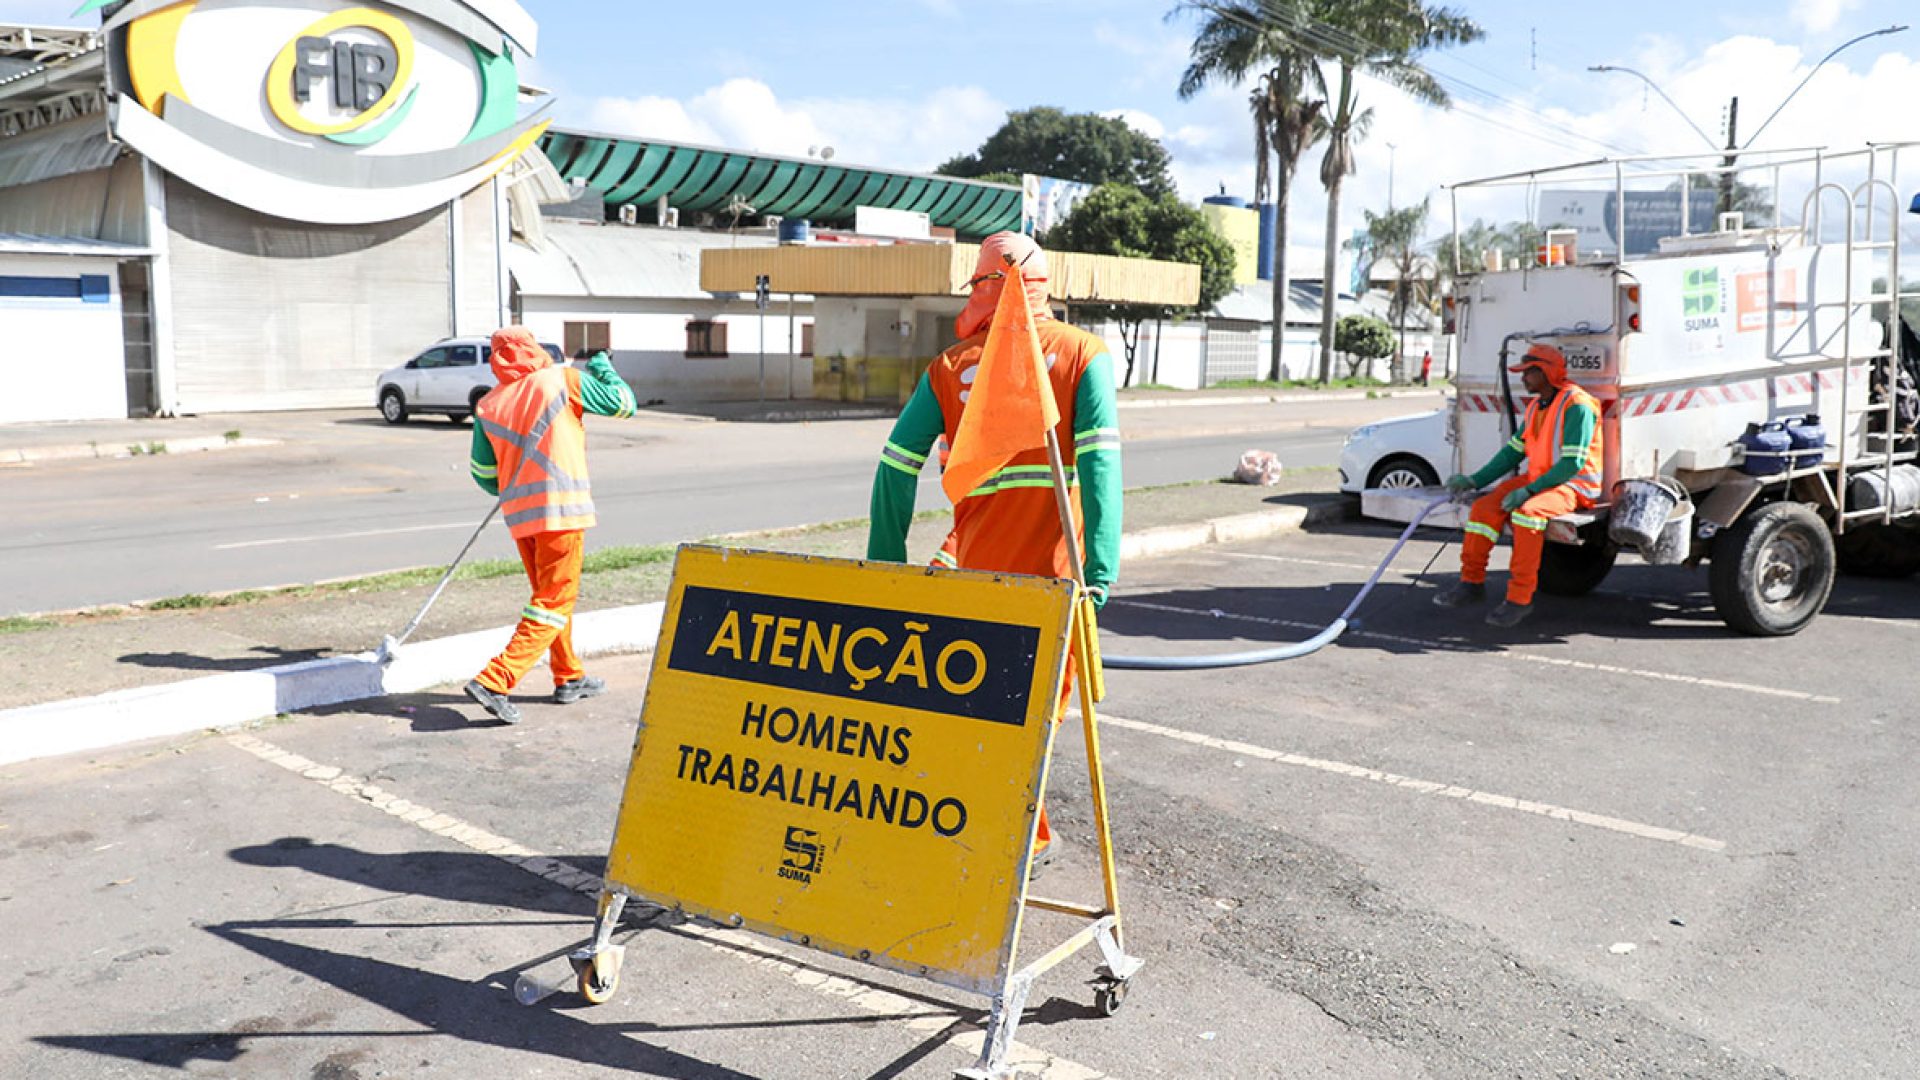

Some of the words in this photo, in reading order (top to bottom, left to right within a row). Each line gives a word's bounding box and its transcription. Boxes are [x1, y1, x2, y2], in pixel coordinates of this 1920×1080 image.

[293, 36, 399, 111] FIB
[1684, 317, 1719, 332] SUMA
[1564, 355, 1601, 370] -0365
[706, 610, 988, 695] ATENÇÃO
[741, 701, 912, 766] HOMENS
[677, 744, 968, 837] TRABALHANDO
[777, 866, 812, 884] SUMA
